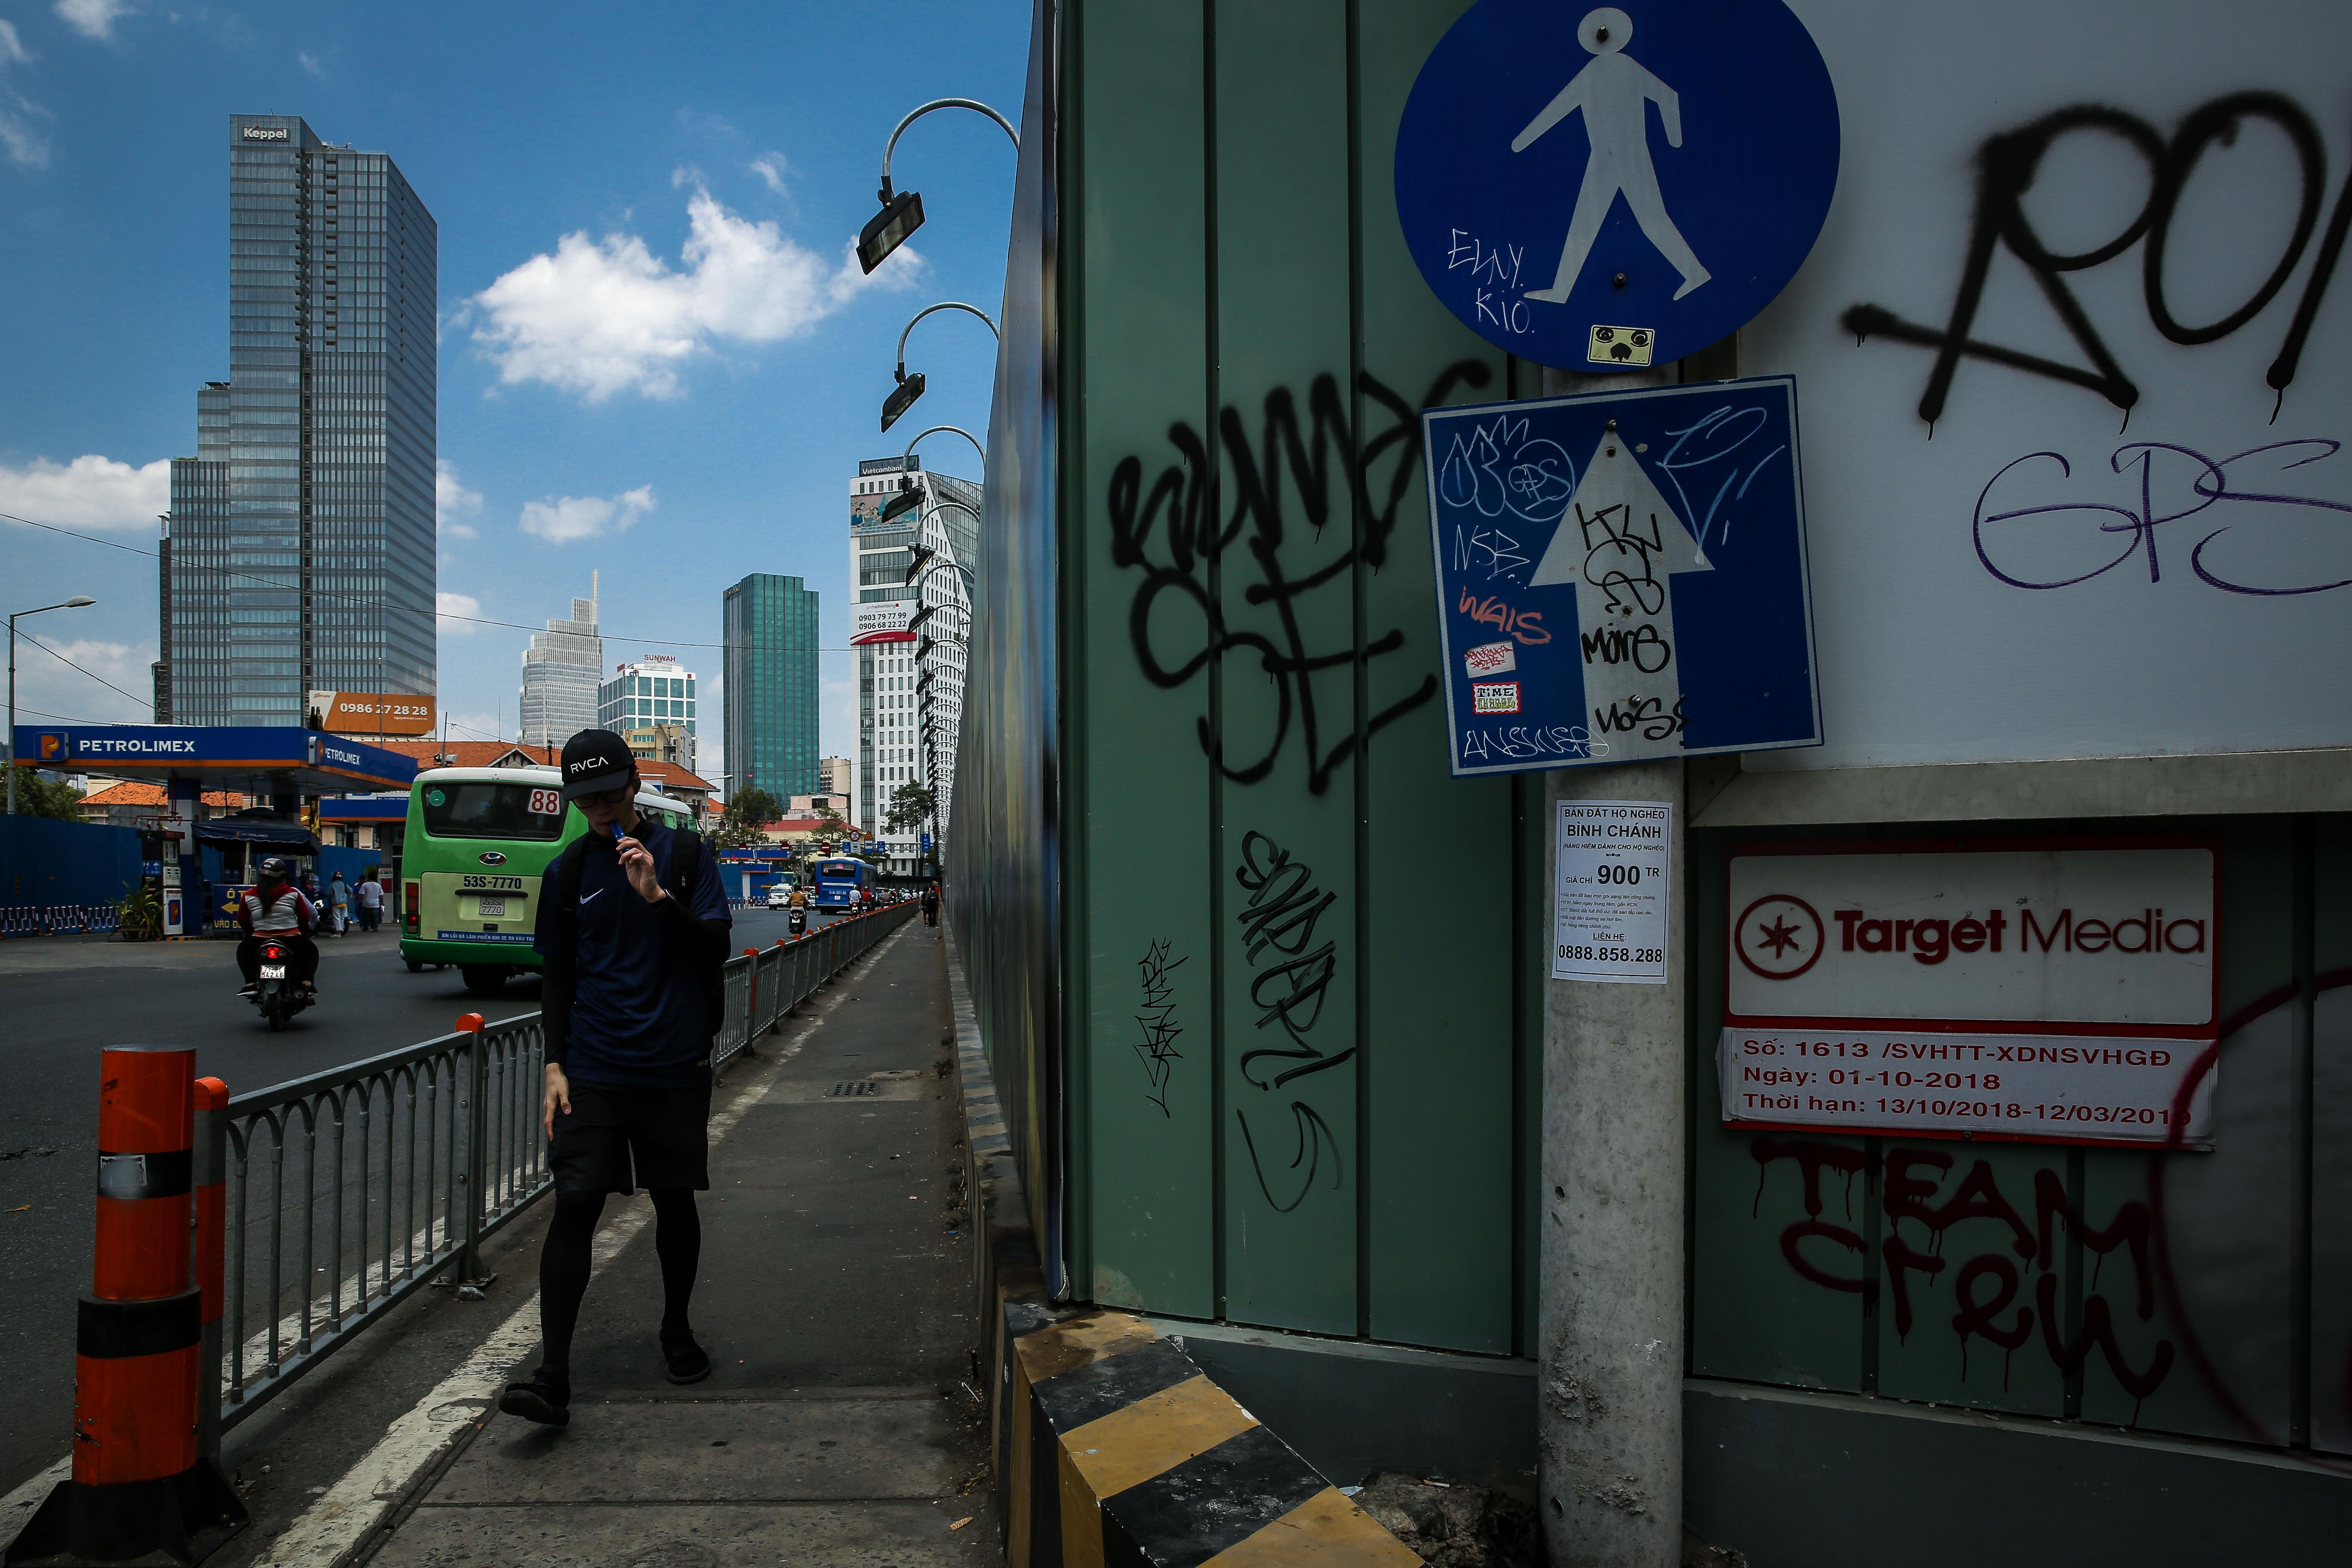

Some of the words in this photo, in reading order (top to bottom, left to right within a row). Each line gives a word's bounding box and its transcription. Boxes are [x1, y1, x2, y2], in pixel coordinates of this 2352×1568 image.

[244, 127, 287, 140] Keppel
[862, 464, 903, 474] Vietcombank
[340, 702, 373, 714] 0986
[375, 704, 392, 714] 27
[393, 705, 410, 715] 28
[412, 706, 428, 716] 28
[80, 740, 195, 752] PETROLIMEX
[570, 757, 609, 773] RVCA
[531, 790, 558, 814] 88
[1564, 806, 1584, 817] BÁN
[1586, 807, 1608, 817] ĐẤT
[1611, 808, 1627, 820] HỘ
[1630, 808, 1665, 820] NGHÈO
[1567, 821, 1602, 837] BÌNH
[1607, 822, 1661, 839] CHÁNH
[1643, 844, 1665, 852] NGHÈO)
[463, 875, 522, 889] 53S-7770
[1566, 875, 1578, 884] GIÁ
[1579, 876, 1593, 884] CHỈ
[1597, 864, 1641, 885] 900
[1645, 866, 1660, 878] TR
[227, 888, 236, 899] Ô
[214, 918, 229, 928] VÀO
[1592, 931, 1611, 940] LIÊN
[1834, 909, 2006, 965] Target
[2021, 909, 2205, 952] Media
[1558, 944, 1663, 963] 0888.858.288
[1743, 1038, 1785, 1056] Số:
[1795, 1041, 1869, 1058] 1613
[1881, 1042, 2171, 1067] /SVHTT-XDNSVHGĐ
[1743, 1066, 1817, 1087] Ngày:
[1828, 1069, 2001, 1090] 01-10-2018
[1742, 1093, 1799, 1110] Thời
[1808, 1095, 1865, 1114] hạn:
[1751, 1137, 2152, 1320] TEAM
